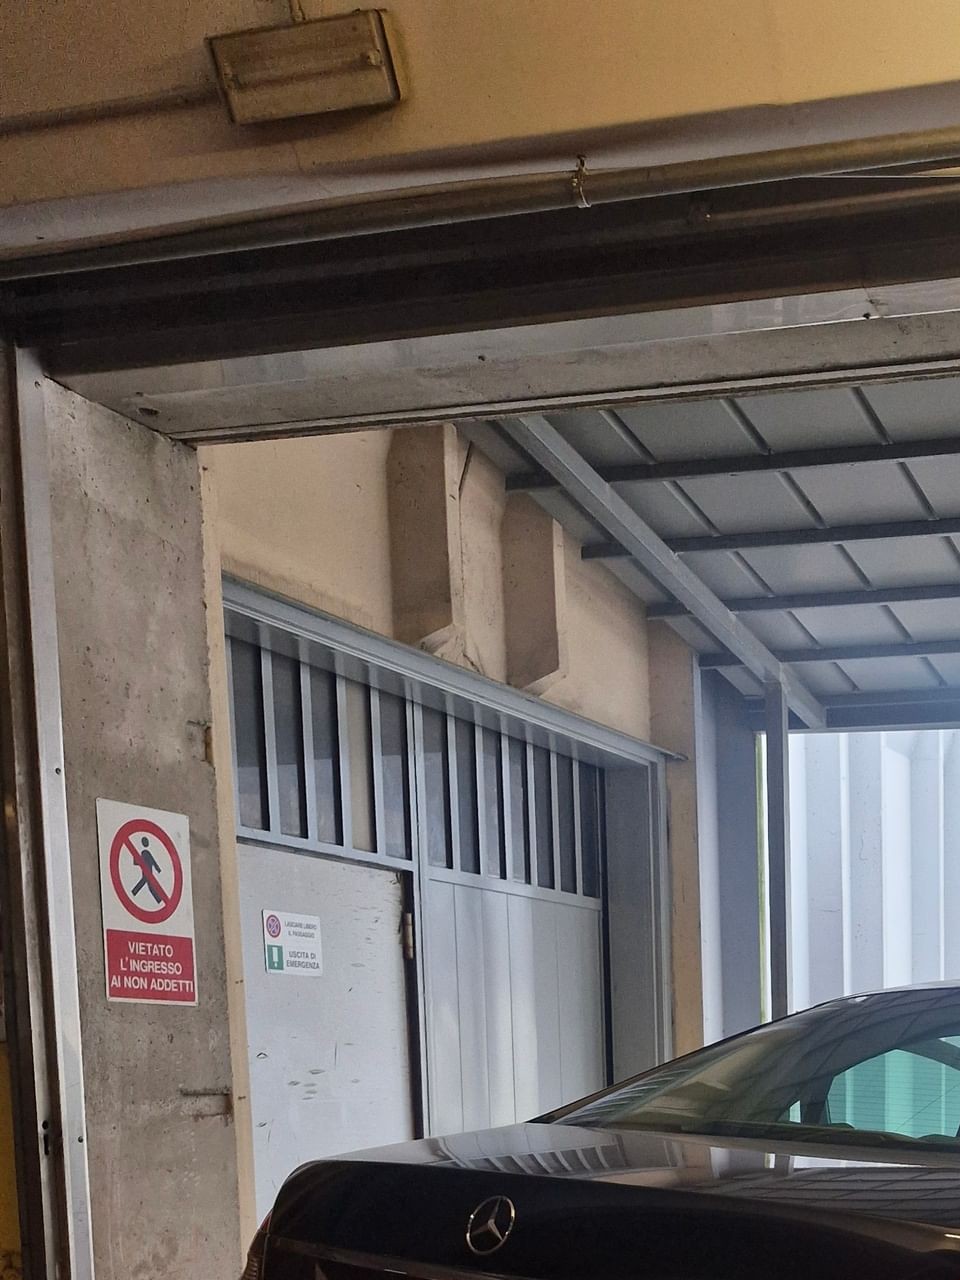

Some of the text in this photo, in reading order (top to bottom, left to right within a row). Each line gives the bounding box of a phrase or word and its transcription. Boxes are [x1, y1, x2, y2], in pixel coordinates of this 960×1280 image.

[128, 941, 173, 957] VIETATO
[289, 951, 309, 959] USCITA
[286, 960, 319, 969] EMERGENZA
[111, 975, 194, 993] AI NON ADDETTI
